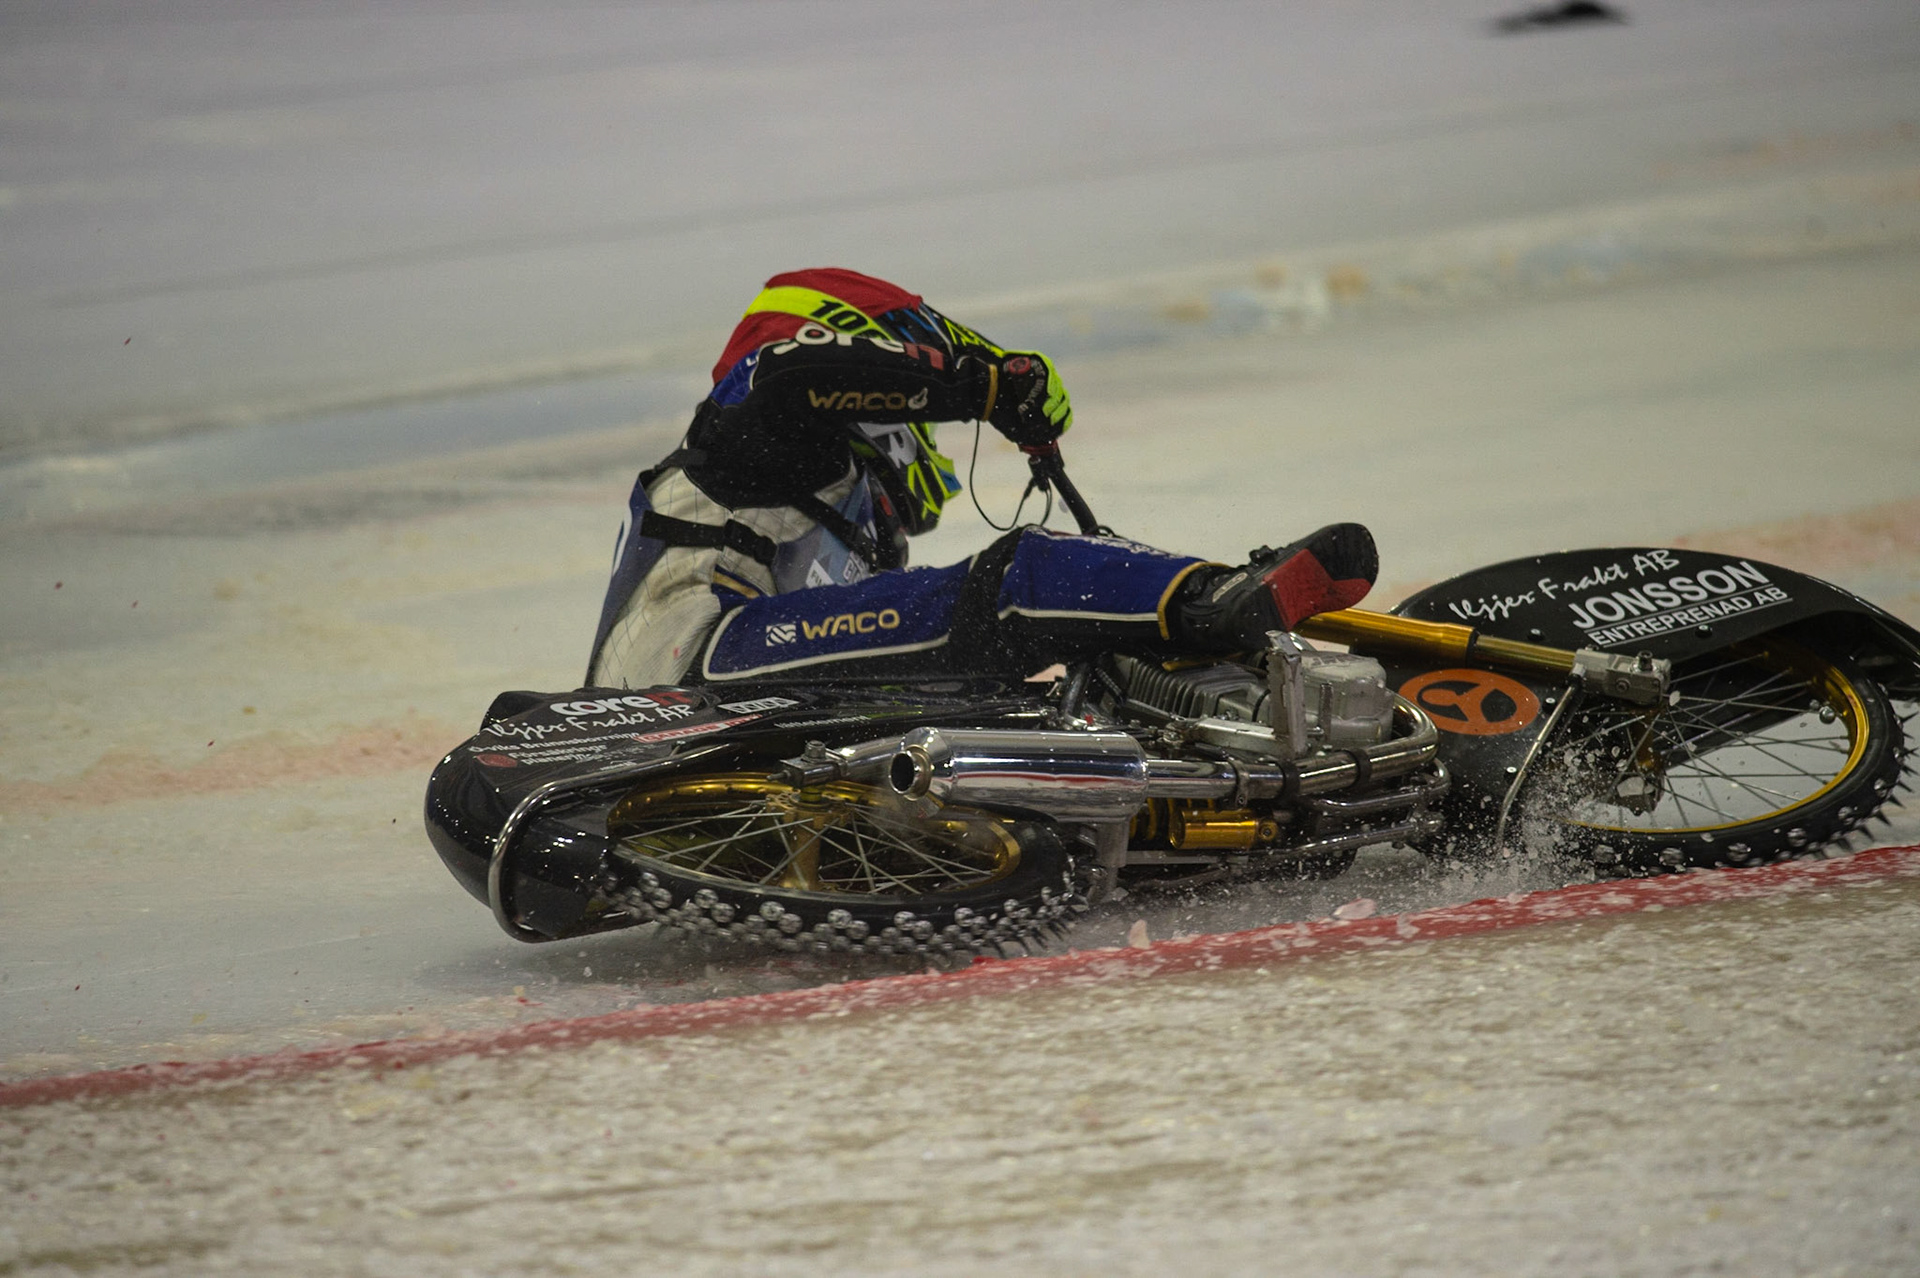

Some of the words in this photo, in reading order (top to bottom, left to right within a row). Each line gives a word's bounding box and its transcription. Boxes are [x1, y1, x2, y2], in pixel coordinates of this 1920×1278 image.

[807, 389, 907, 412] WACO
[1632, 548, 1681, 576] AB
[1567, 560, 1772, 630] JONSSON
[802, 608, 901, 641] WACO
[1588, 595, 1752, 647] ENTREPRENAD
[1753, 586, 1789, 605] AB
